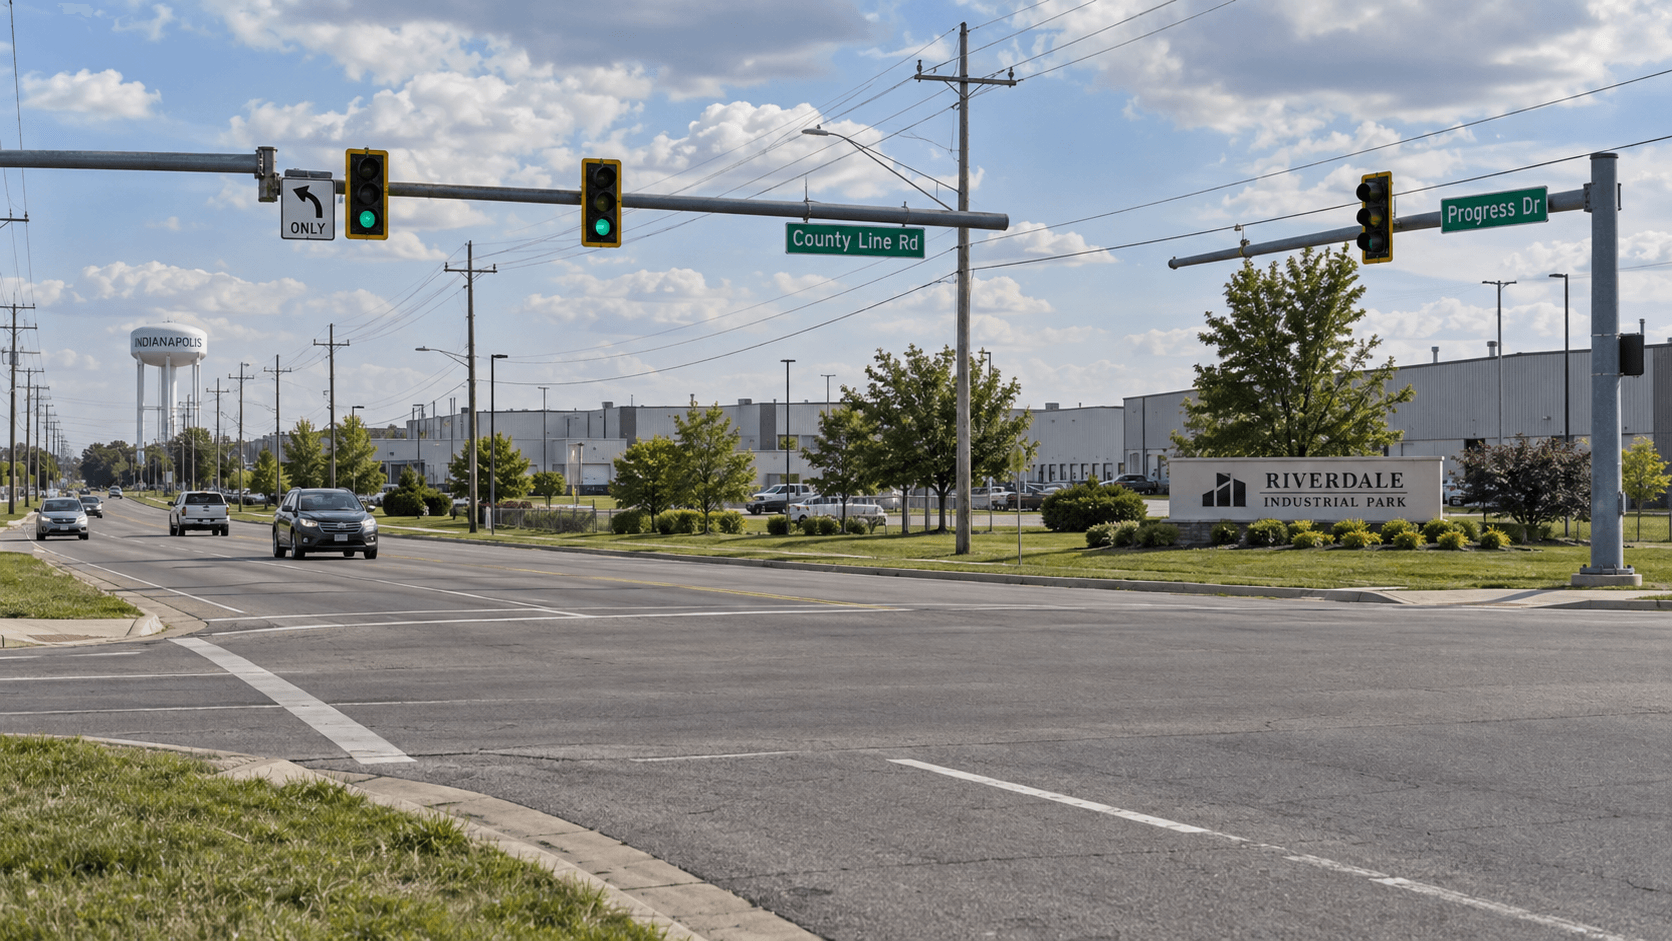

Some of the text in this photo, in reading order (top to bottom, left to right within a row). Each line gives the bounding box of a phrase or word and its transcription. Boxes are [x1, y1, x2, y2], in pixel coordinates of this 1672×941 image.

[1447, 196, 1540, 226] Progress Dr
[290, 221, 326, 235] ONLY
[792, 229, 919, 253] County Line Rd
[134, 336, 203, 348] INDIANAPOLIS
[1264, 472, 1405, 490] RIVERDALE
[1263, 496, 1408, 509] INDUSTRIAL PARK
